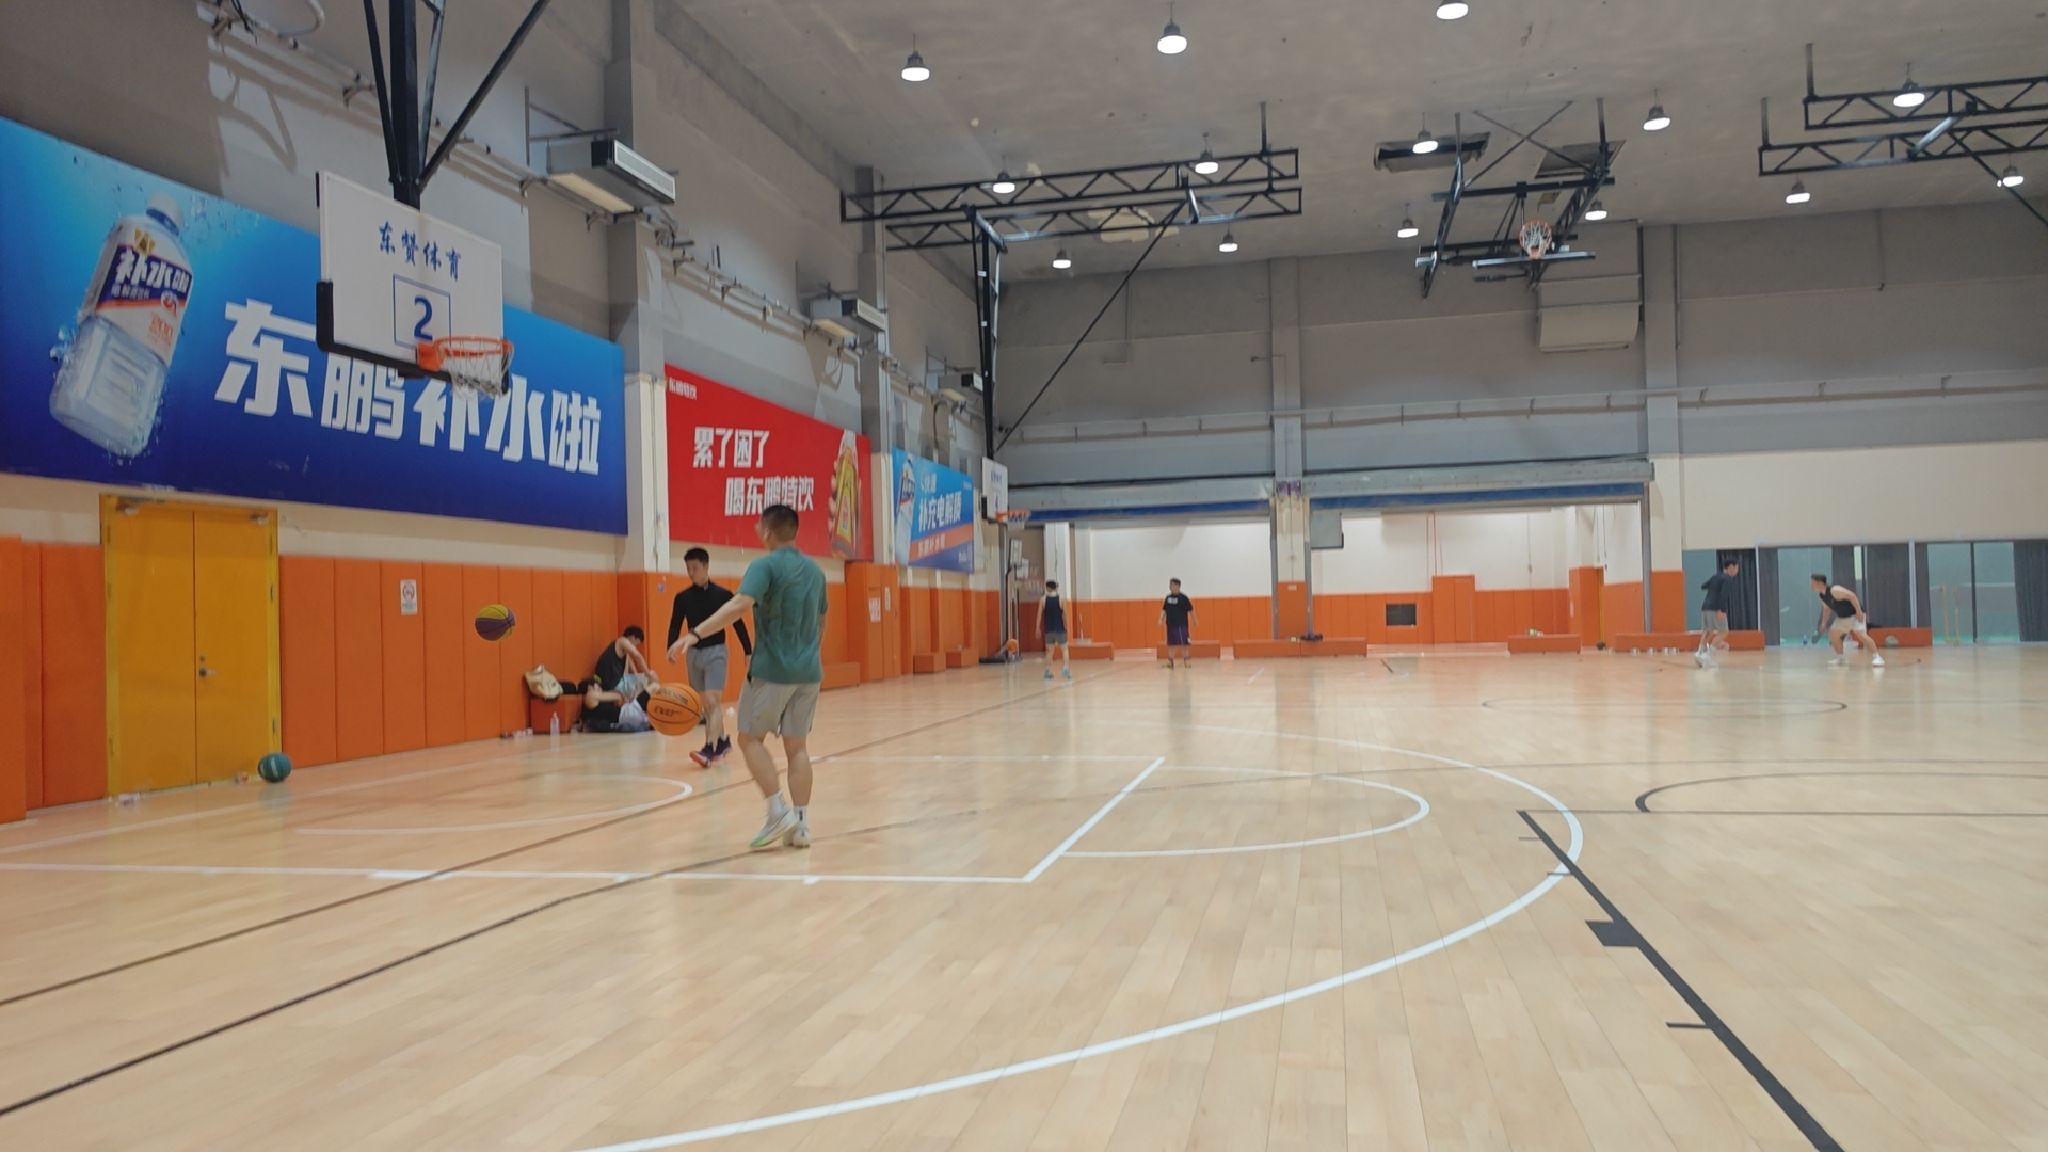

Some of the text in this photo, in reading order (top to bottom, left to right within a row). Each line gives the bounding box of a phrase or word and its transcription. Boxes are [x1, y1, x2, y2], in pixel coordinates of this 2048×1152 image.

[114, 249, 191, 294] 补水啦
[379, 220, 461, 282] 东赞体育
[413, 296, 433, 341] 2
[213, 298, 602, 476] 东鹏补水啦
[693, 426, 770, 469] 累了困了
[724, 475, 815, 517] 喝东鹏特饮
